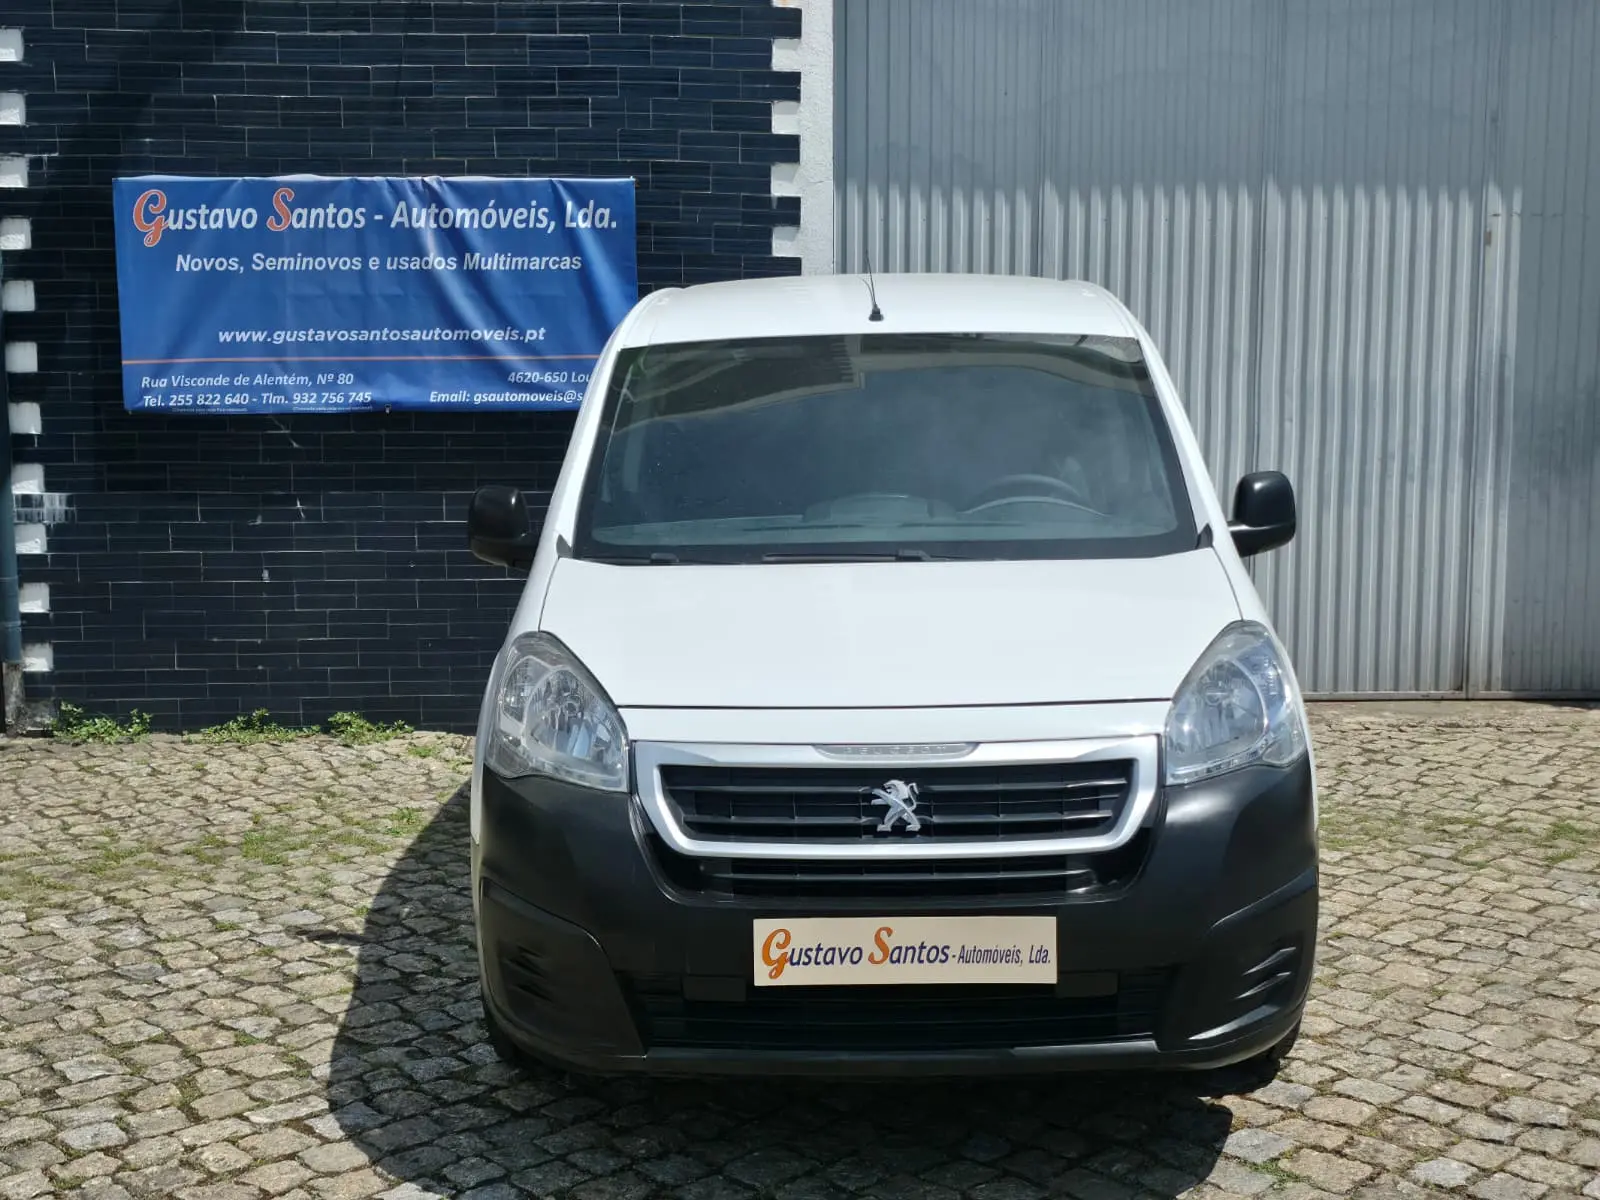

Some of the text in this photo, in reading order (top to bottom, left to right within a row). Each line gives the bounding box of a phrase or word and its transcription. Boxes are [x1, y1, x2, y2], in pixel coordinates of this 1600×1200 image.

[132, 189, 258, 248] Gustavo
[266, 187, 366, 232] Santos
[390, 199, 556, 234] Automóveis,
[564, 200, 617, 229] Lda.
[175, 252, 583, 274] Novos, Seminovos e usados Multimarcas
[218, 326, 547, 345] www.gustavosantosautomoveis.pt
[141, 375, 168, 389] Rua
[171, 373, 230, 388] Visconde
[233, 373, 250, 387] de
[252, 372, 312, 388] Alentém,
[337, 372, 354, 386] 80
[507, 371, 569, 385] 4620-650
[143, 394, 165, 408] Tel.
[169, 394, 193, 407] 255
[196, 394, 221, 406] 822
[224, 393, 250, 405] 640
[261, 393, 289, 405] Tlm.
[292, 392, 317, 404] 932
[321, 391, 345, 404] 756
[347, 391, 373, 403] 745
[429, 390, 471, 403] Email:
[761, 928, 863, 980] Gustavo
[867, 926, 950, 966] Santos
[957, 944, 1024, 967] Automóveis,
[1028, 945, 1052, 964] Lda.
